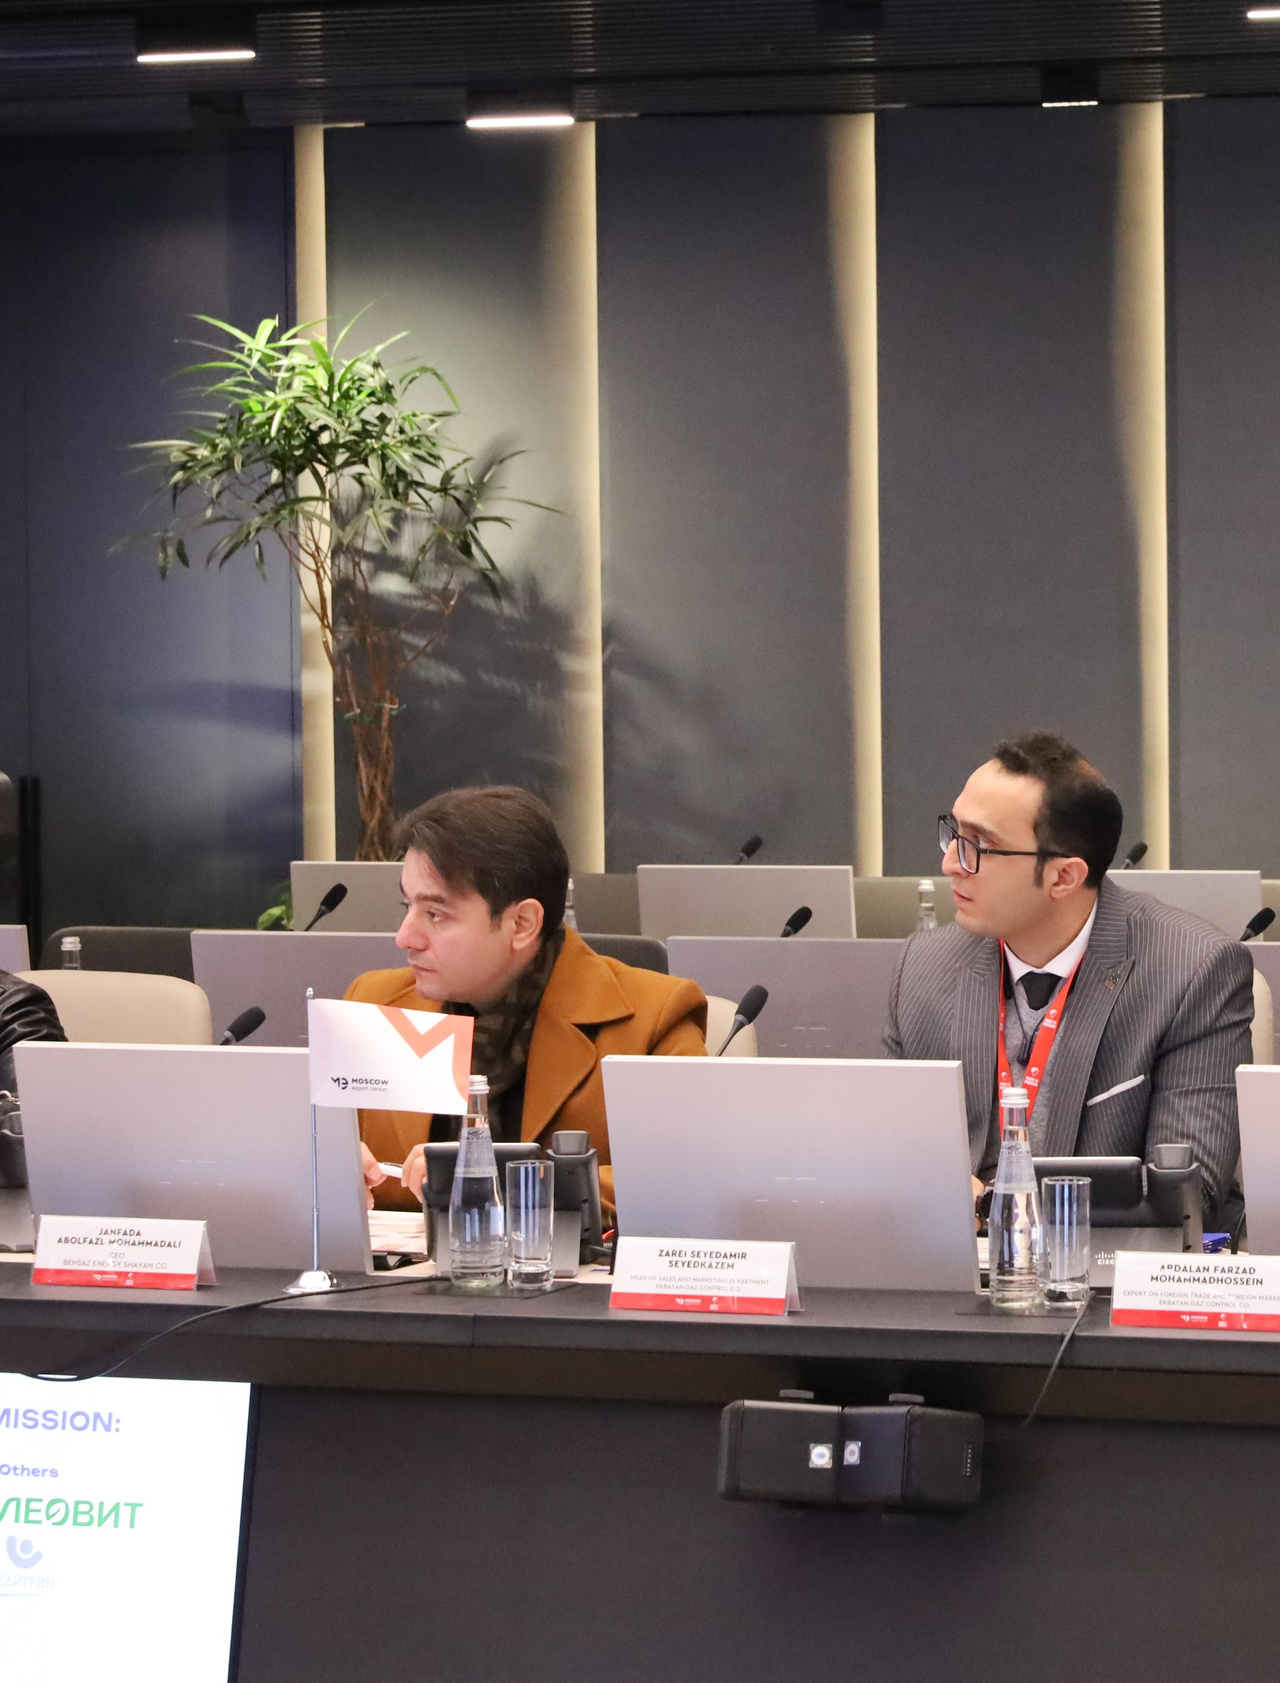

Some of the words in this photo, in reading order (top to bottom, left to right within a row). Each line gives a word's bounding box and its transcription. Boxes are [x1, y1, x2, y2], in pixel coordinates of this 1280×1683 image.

[351, 1078, 389, 1086] MOSCOW
[99, 1228, 142, 1236] JANFADA
[57, 1236, 105, 1246] ABOLFAZL
[108, 1238, 182, 1248] MOHAMMADALI
[658, 1249, 688, 1258] ZAREI
[690, 1250, 747, 1260] SEYEDAMIR
[63, 1258, 91, 1266] BEHSAZ
[123, 1261, 154, 1269] SHAYAN
[155, 1262, 169, 1270] CO.
[668, 1260, 735, 1270] SEYEDKAZEM
[1214, 1266, 1256, 1275] FARZAD
[1150, 1274, 1264, 1286] MOHAMMADHOSSEIN
[698, 1284, 728, 1292] CONTROL
[0, 1464, 59, 1478] Others
[0, 1497, 144, 1529] ЛЕОВИТ
